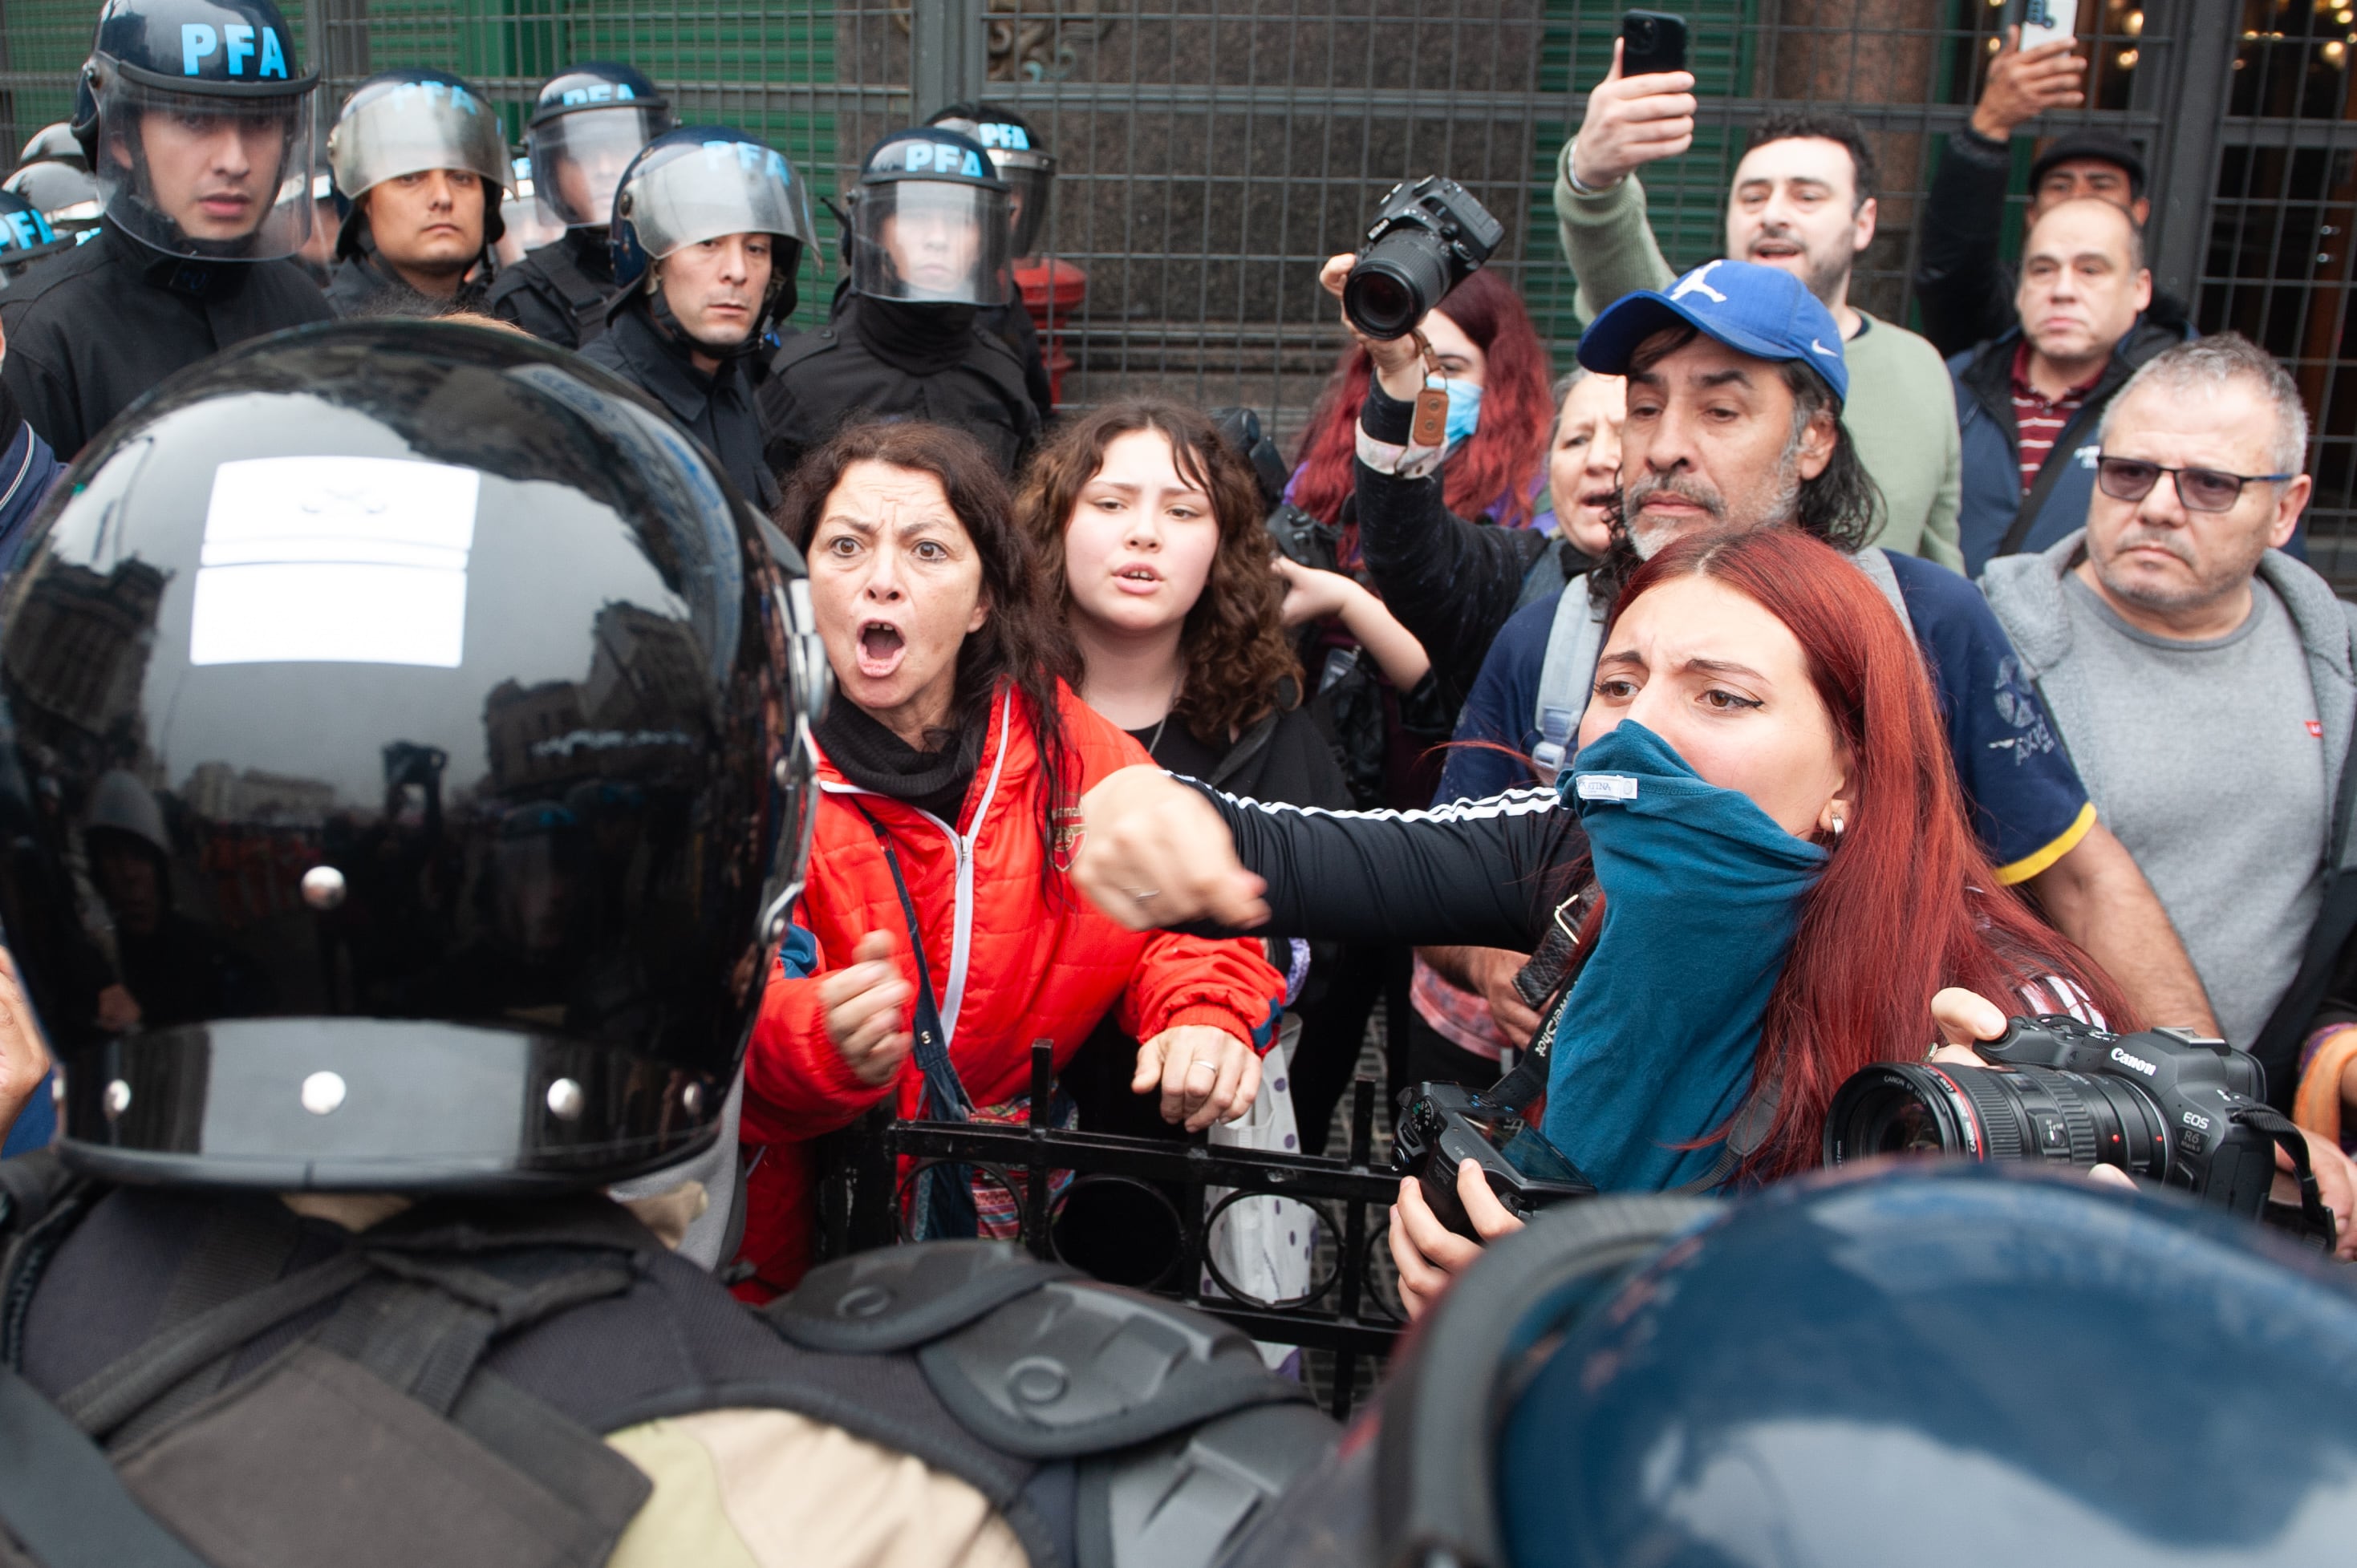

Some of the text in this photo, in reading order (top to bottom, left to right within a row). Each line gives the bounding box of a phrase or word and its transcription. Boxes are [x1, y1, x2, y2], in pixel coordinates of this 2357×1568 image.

[181, 23, 288, 79] PFA
[392, 80, 477, 115] PFA
[979, 123, 1030, 151] PFA
[703, 140, 790, 187] PFA
[906, 144, 983, 177] PFA
[2111, 1047, 2156, 1076] Canon
[1884, 1075, 1905, 1087] CANON
[2183, 1112, 2209, 1129] EOS
[2184, 1130, 2200, 1144] R6
